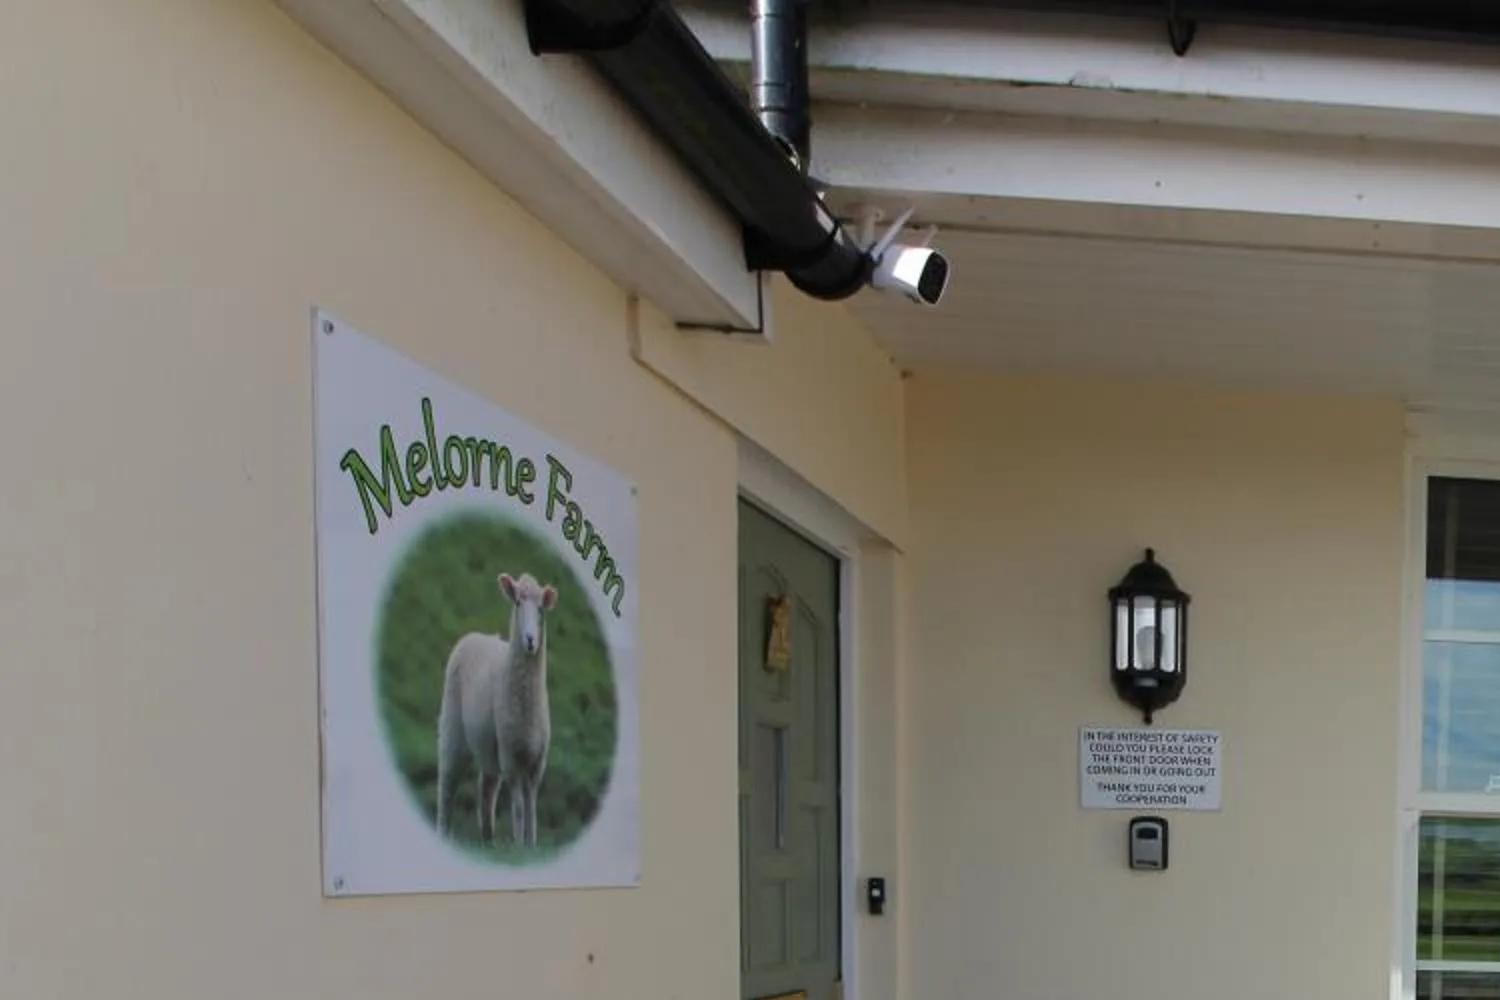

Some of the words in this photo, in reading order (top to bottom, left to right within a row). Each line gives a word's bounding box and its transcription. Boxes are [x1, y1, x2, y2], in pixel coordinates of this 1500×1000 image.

[340, 397, 536, 535] Melorne
[545, 453, 625, 618] Farm
[1084, 732, 1095, 741] IN
[1096, 732, 1113, 741] THE
[1117, 732, 1162, 742] INTEREST
[1165, 733, 1178, 742] OF
[1182, 734, 1219, 744] SAFETY
[1089, 743, 1124, 752] COULD
[1125, 743, 1147, 752] YOU
[1150, 745, 1184, 754] PLEASE
[1187, 746, 1213, 755] LOCK
[1092, 754, 1110, 763] THE
[1113, 755, 1145, 764] FRONT
[1149, 755, 1178, 765] DOOR
[1180, 756, 1211, 766] WHEN
[1086, 766, 1128, 775] COMING
[1130, 766, 1140, 776] IN
[1143, 766, 1157, 776] OR
[1160, 767, 1193, 777] GOING
[1194, 768, 1216, 777] OUT
[1097, 782, 1133, 792] THANK
[1134, 783, 1155, 793] YOU
[1156, 784, 1176, 793] FOR
[1178, 785, 1205, 794] YOUR
[1115, 795, 1187, 805] COOPERATION
